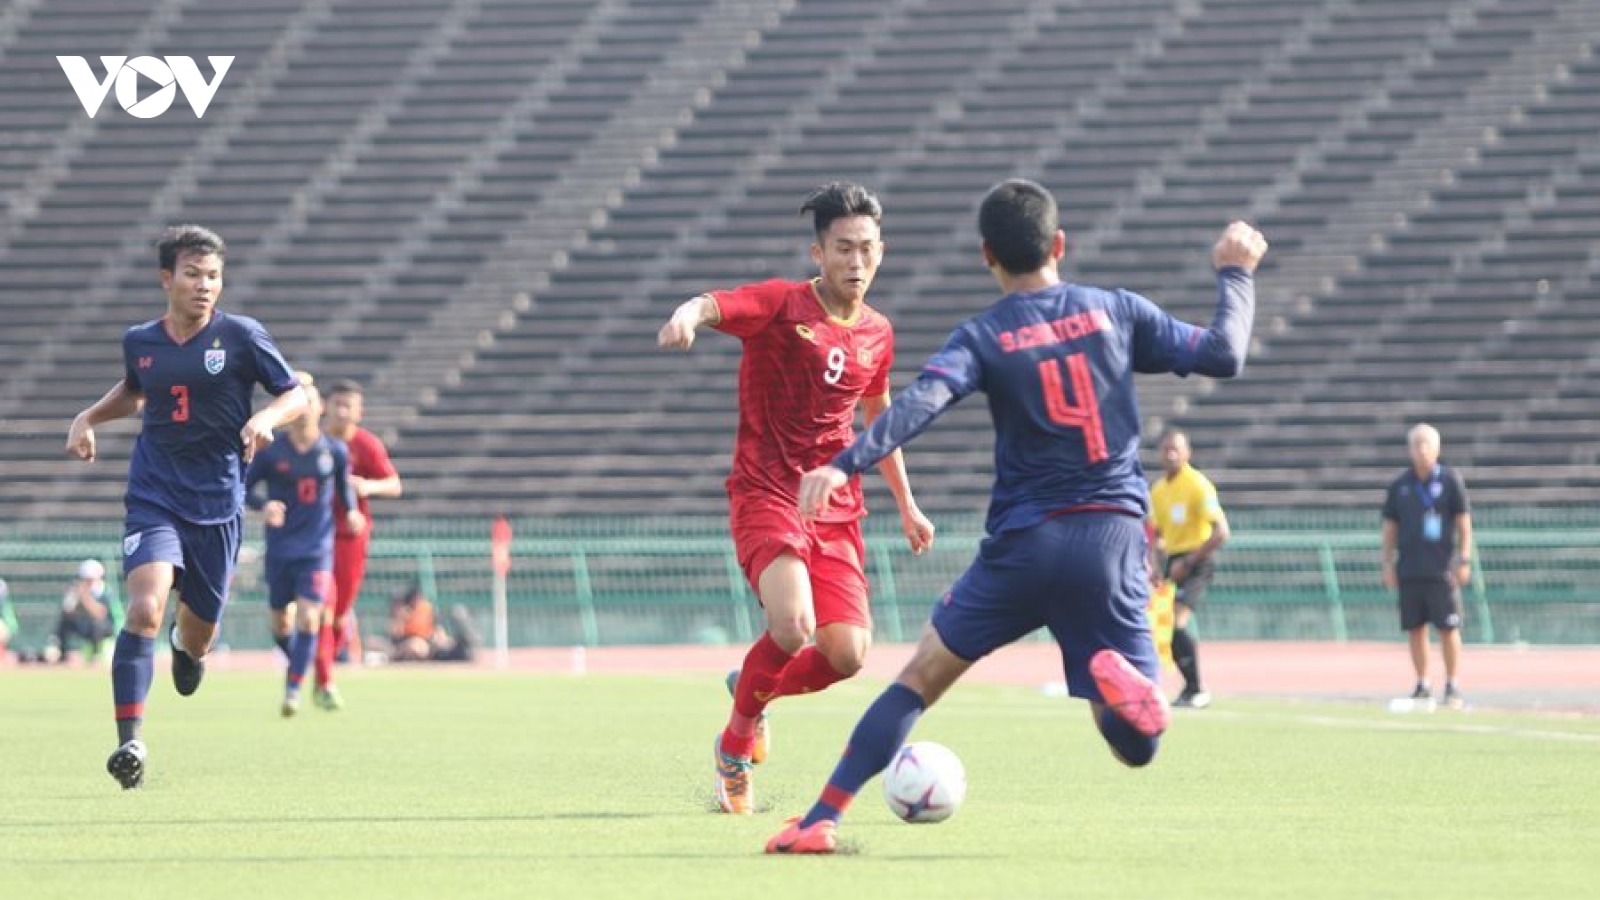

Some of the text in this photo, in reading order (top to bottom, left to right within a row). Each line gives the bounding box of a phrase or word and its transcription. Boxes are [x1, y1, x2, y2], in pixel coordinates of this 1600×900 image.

[824, 346, 845, 384] 9
[170, 385, 190, 422] 3
[1037, 352, 1110, 463] 4
